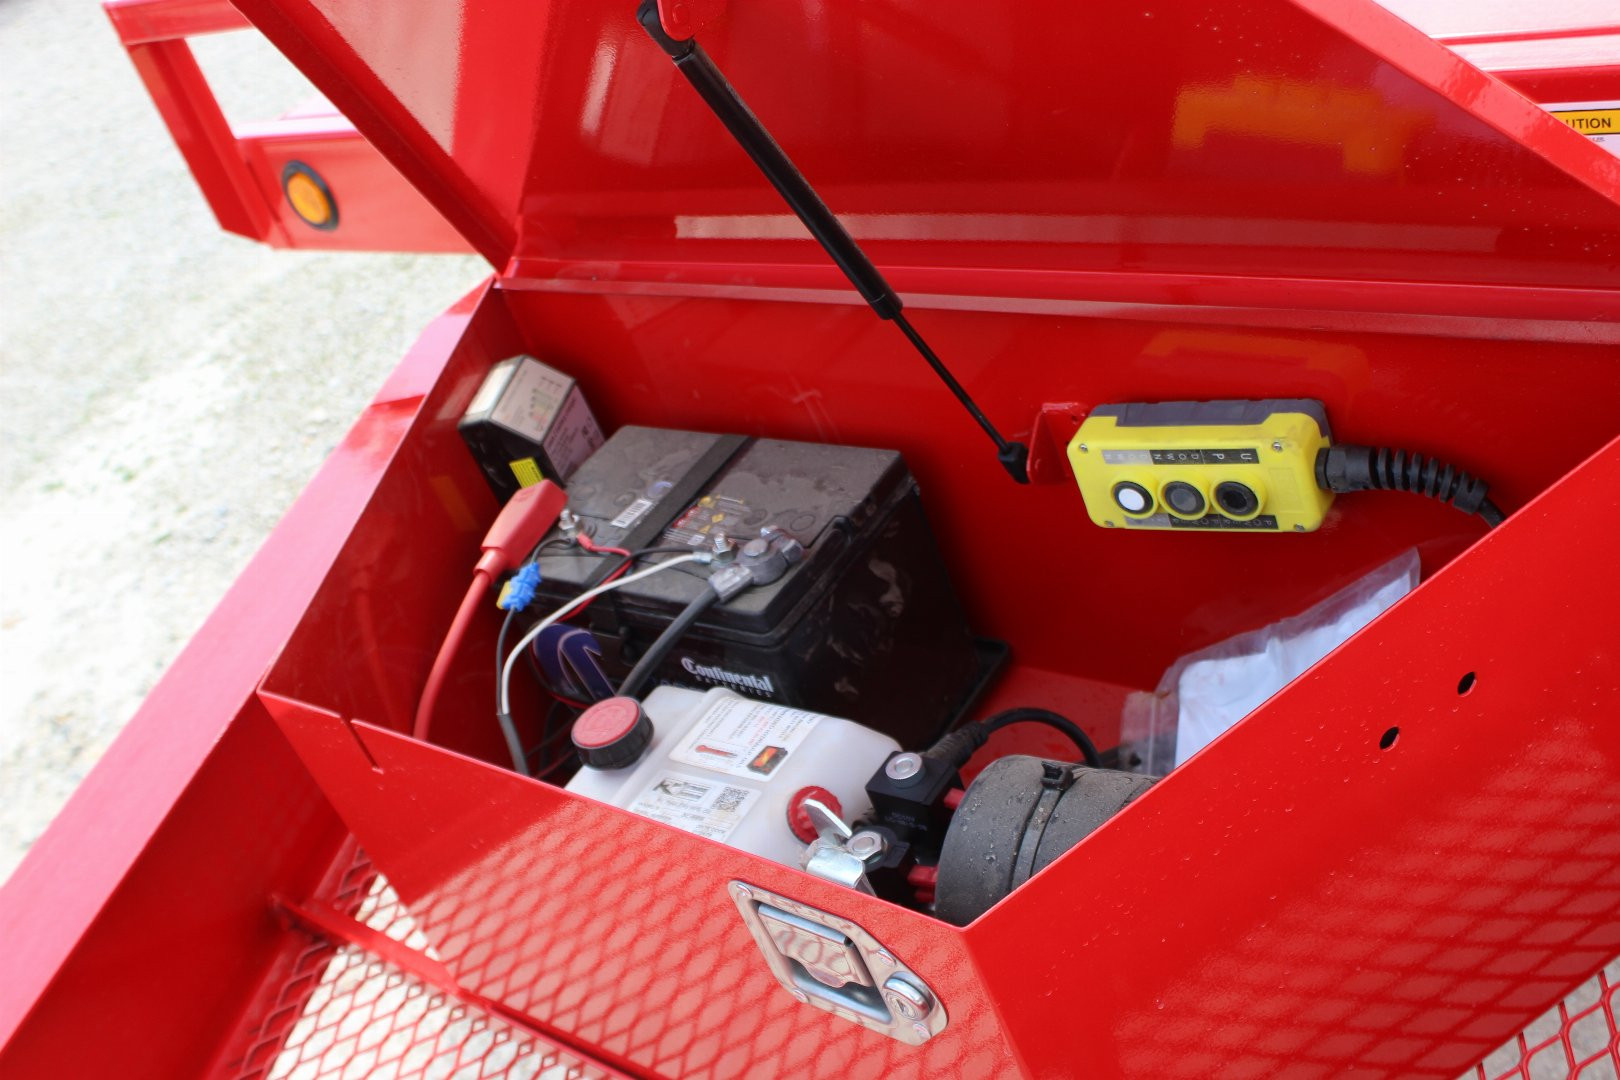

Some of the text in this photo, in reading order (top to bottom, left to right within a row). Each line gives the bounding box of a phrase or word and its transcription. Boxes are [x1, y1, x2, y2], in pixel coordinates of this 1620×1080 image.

[1565, 117, 1612, 129] UTION
[1153, 452, 1200, 461] DOWN
[1211, 452, 1252, 461] UP
[681, 657, 775, 693] Continental
